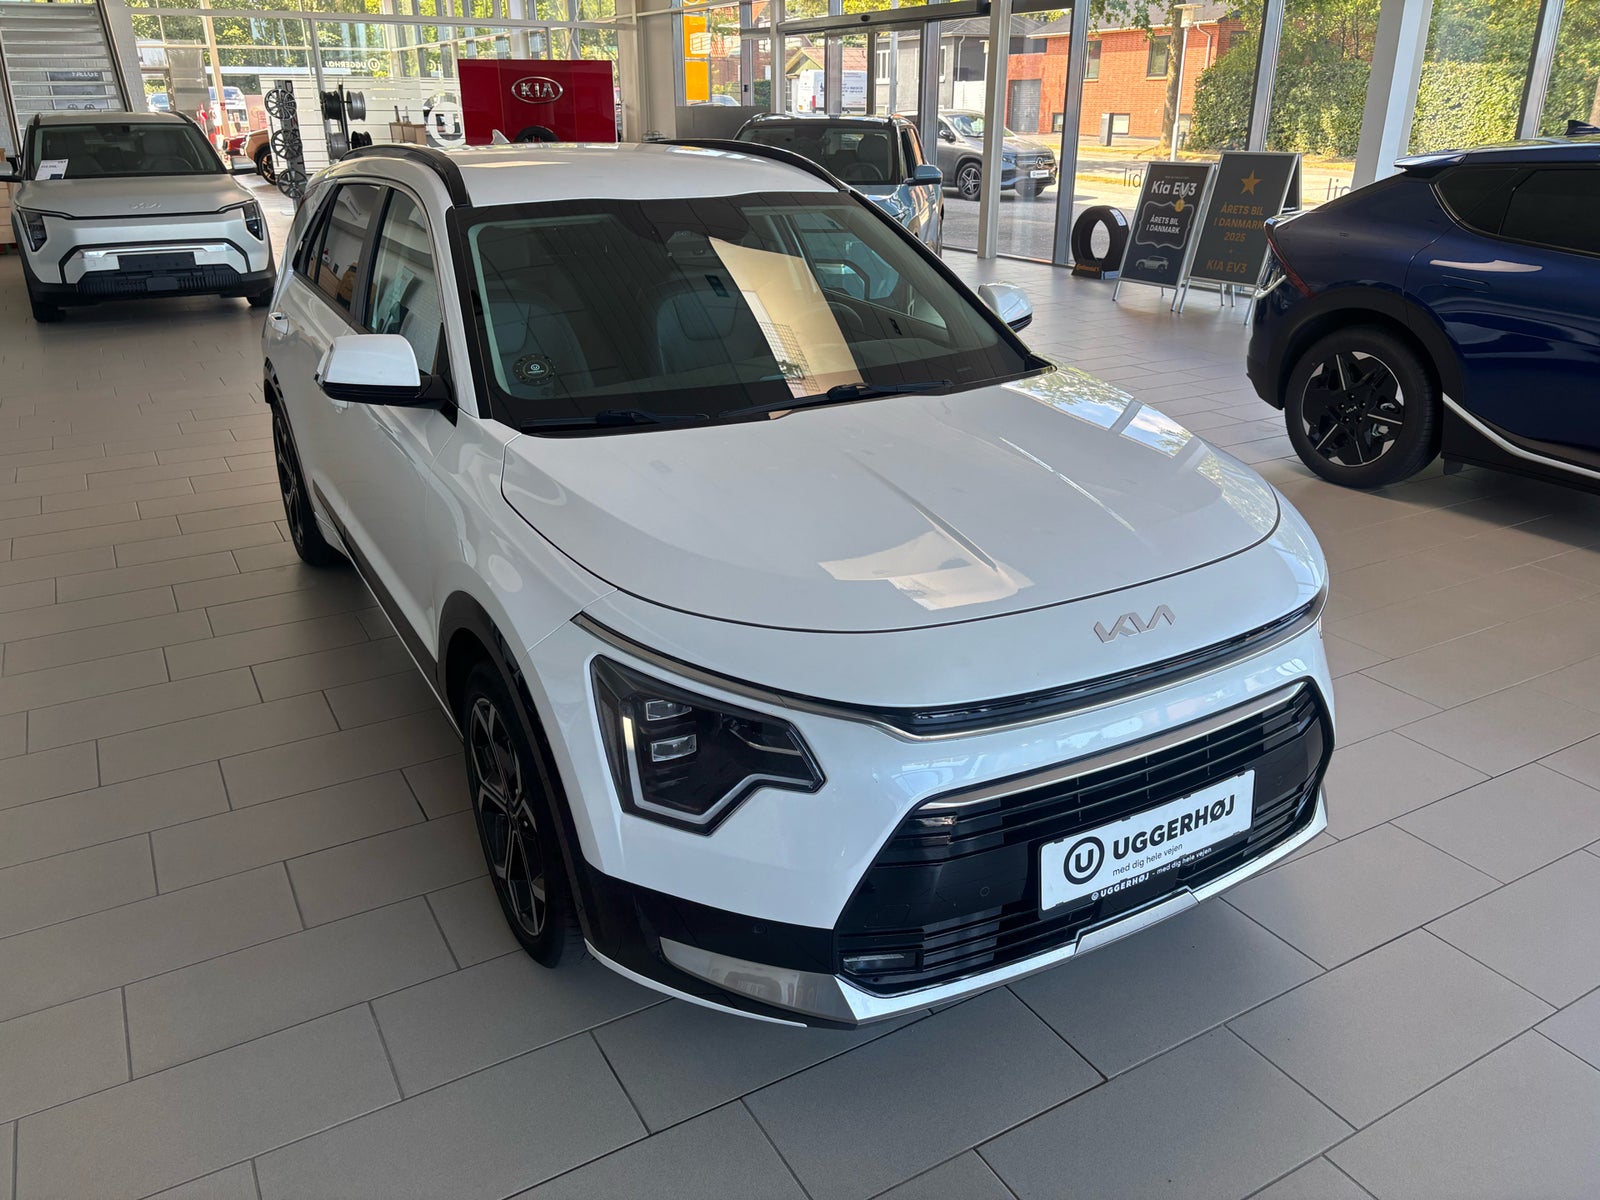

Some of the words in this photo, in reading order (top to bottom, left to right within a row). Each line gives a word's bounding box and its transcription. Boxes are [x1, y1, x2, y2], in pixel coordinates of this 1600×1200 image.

[520, 82, 555, 98] KIA
[1151, 181, 1170, 194] Kia
[1172, 182, 1197, 196] EV3
[1220, 202, 1250, 214] ÅRETS
[1250, 206, 1264, 216] BIL
[1150, 214, 1169, 224] ÅRETS
[1169, 217, 1179, 225] BIL
[1149, 224, 1180, 234] DANMARK
[1224, 232, 1247, 242] 2025
[1206, 259, 1224, 271] KIA
[1226, 261, 1248, 273] EV3
[1093, 604, 1176, 643] KIA
[1112, 794, 1235, 860] UGGERHØJ
[1112, 863, 1130, 877] med
[1132, 858, 1145, 869] dig
[1146, 851, 1162, 865] hele
[1163, 843, 1183, 858] vejen
[1100, 873, 1150, 898] UGGERHØJ
[1156, 865, 1171, 875] med
[1171, 859, 1181, 869] dig
[1181, 854, 1195, 864] hele
[1195, 847, 1212, 859] vejen
